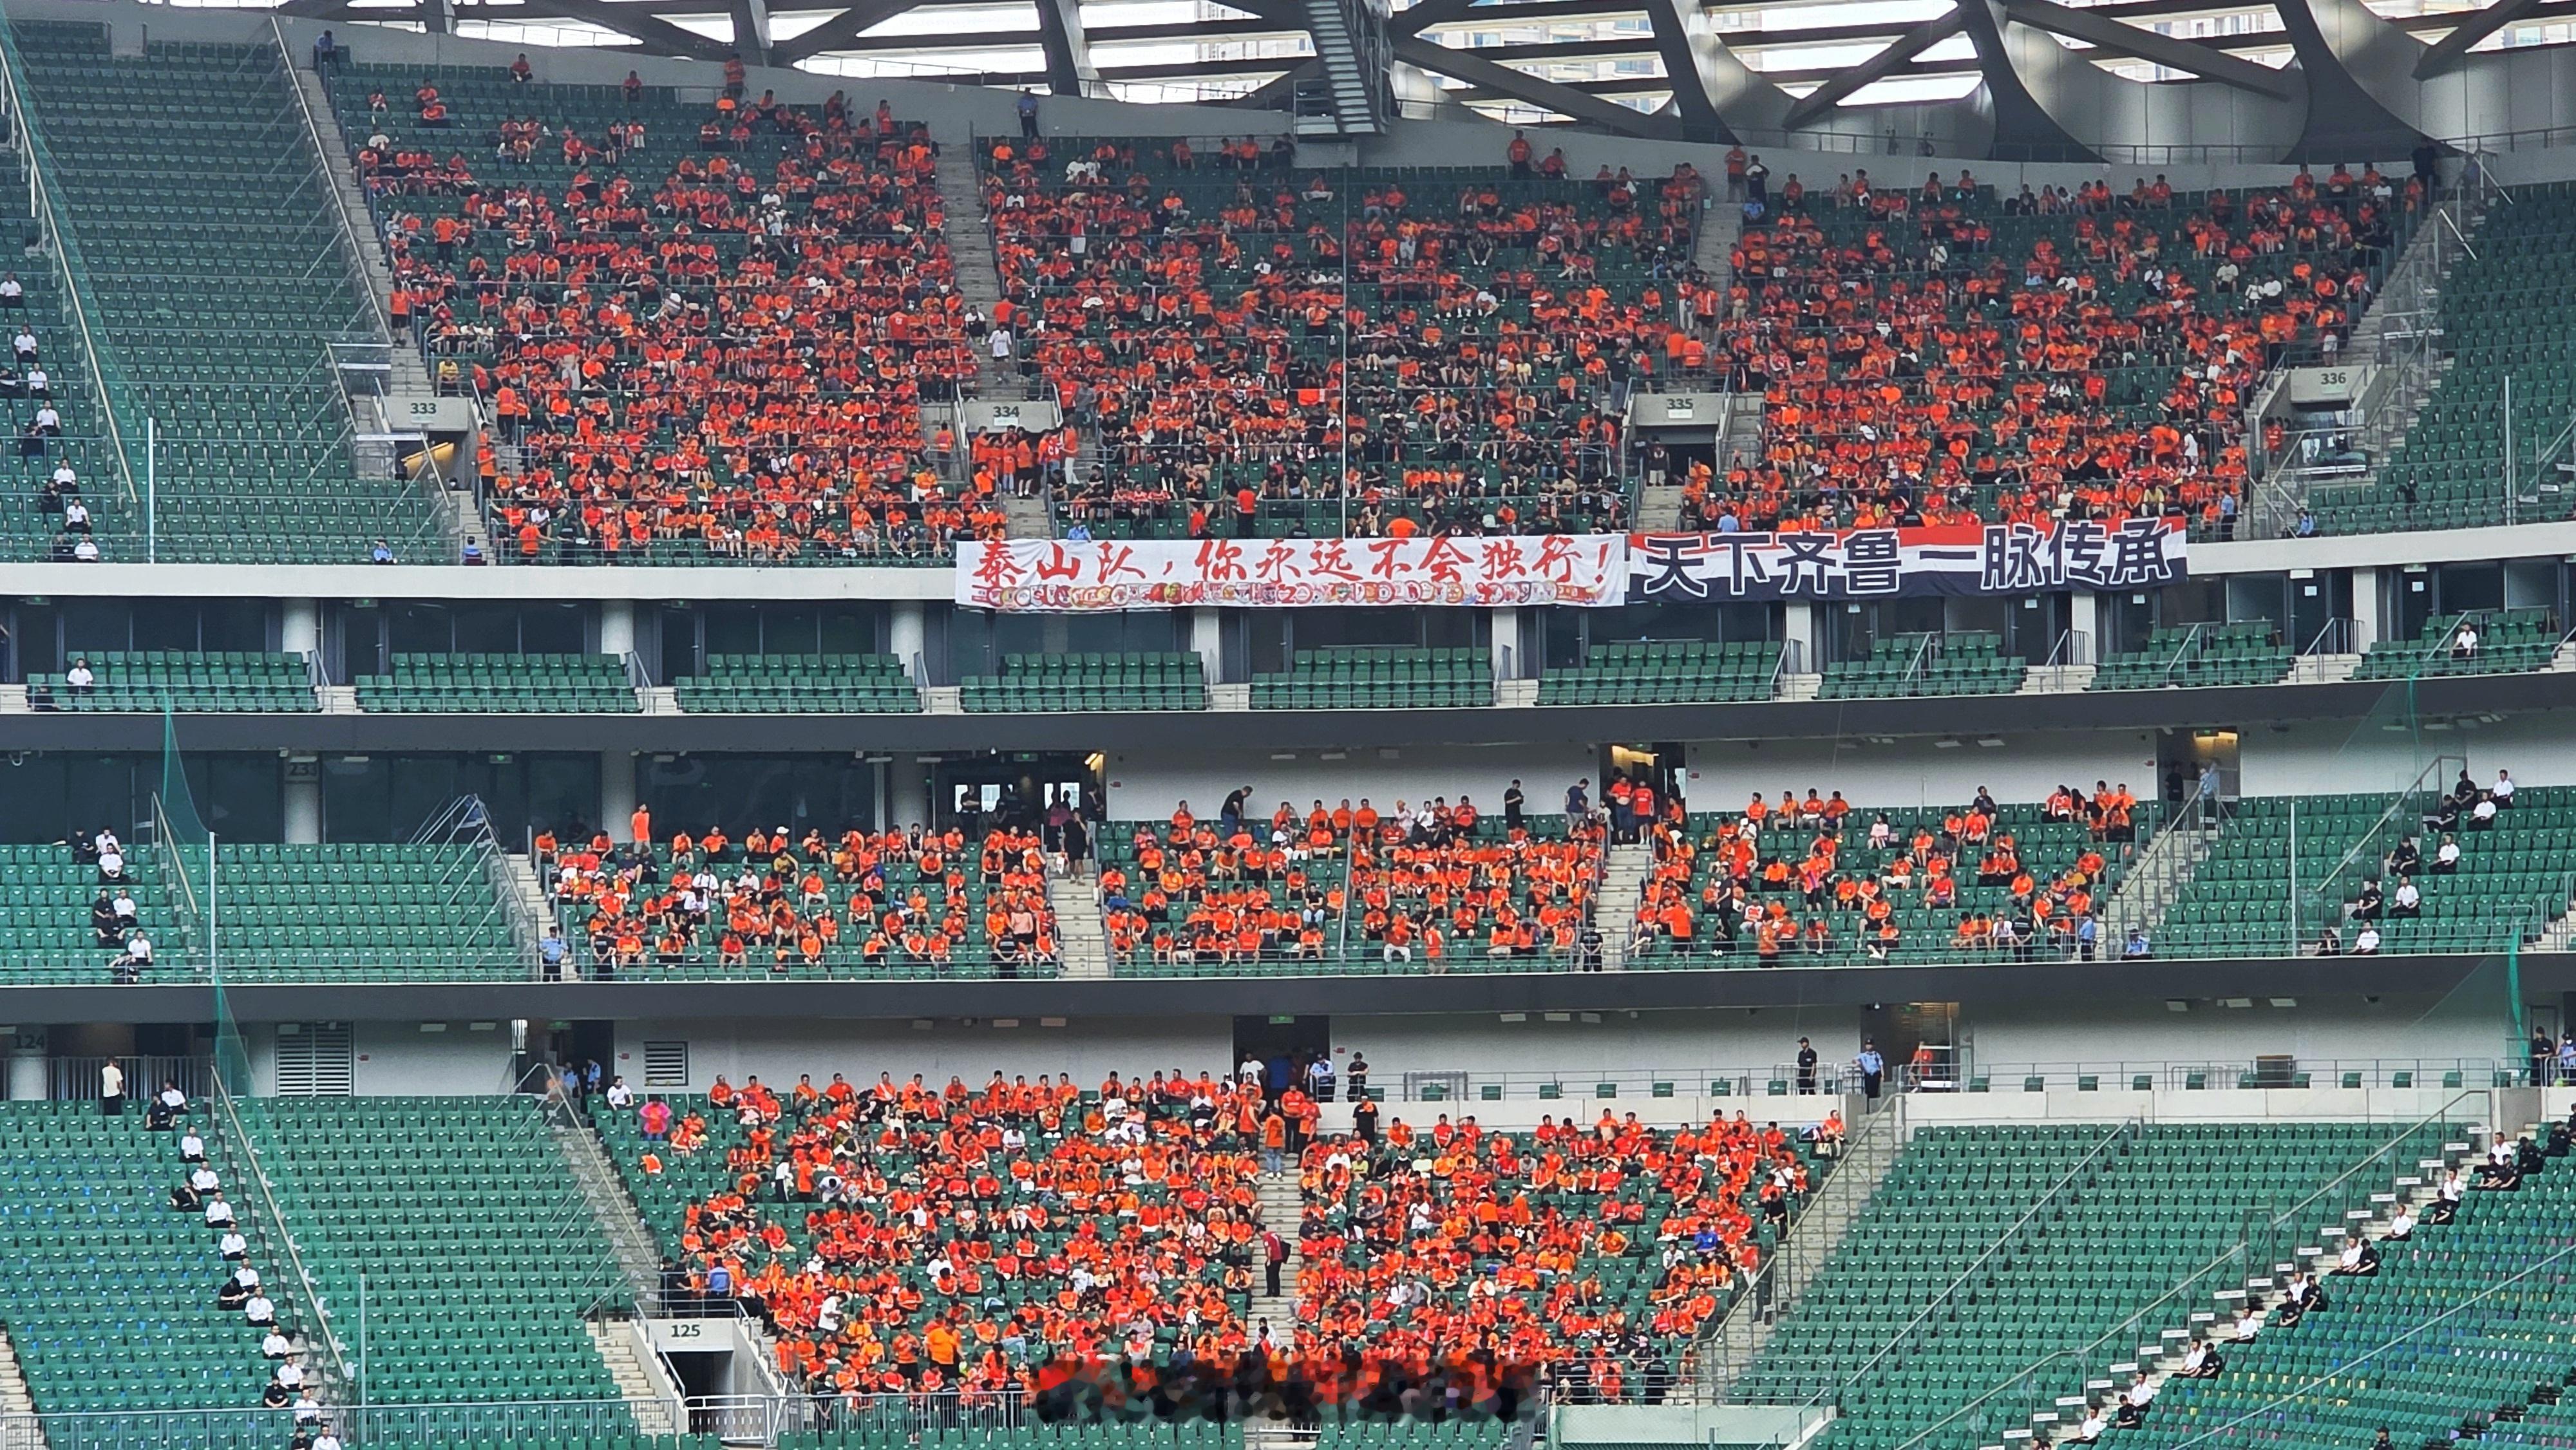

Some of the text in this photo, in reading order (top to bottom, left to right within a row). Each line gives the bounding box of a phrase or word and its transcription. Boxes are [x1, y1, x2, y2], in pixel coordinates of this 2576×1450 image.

[2321, 372, 2347, 384] 336
[410, 402, 437, 414] 333
[1667, 398, 1693, 410] 335
[993, 406, 1019, 418] 334
[1644, 517, 2172, 597] 天下齐鲁一脉传承
[14, 1034, 45, 1049] 124
[671, 1324, 701, 1337] 125
